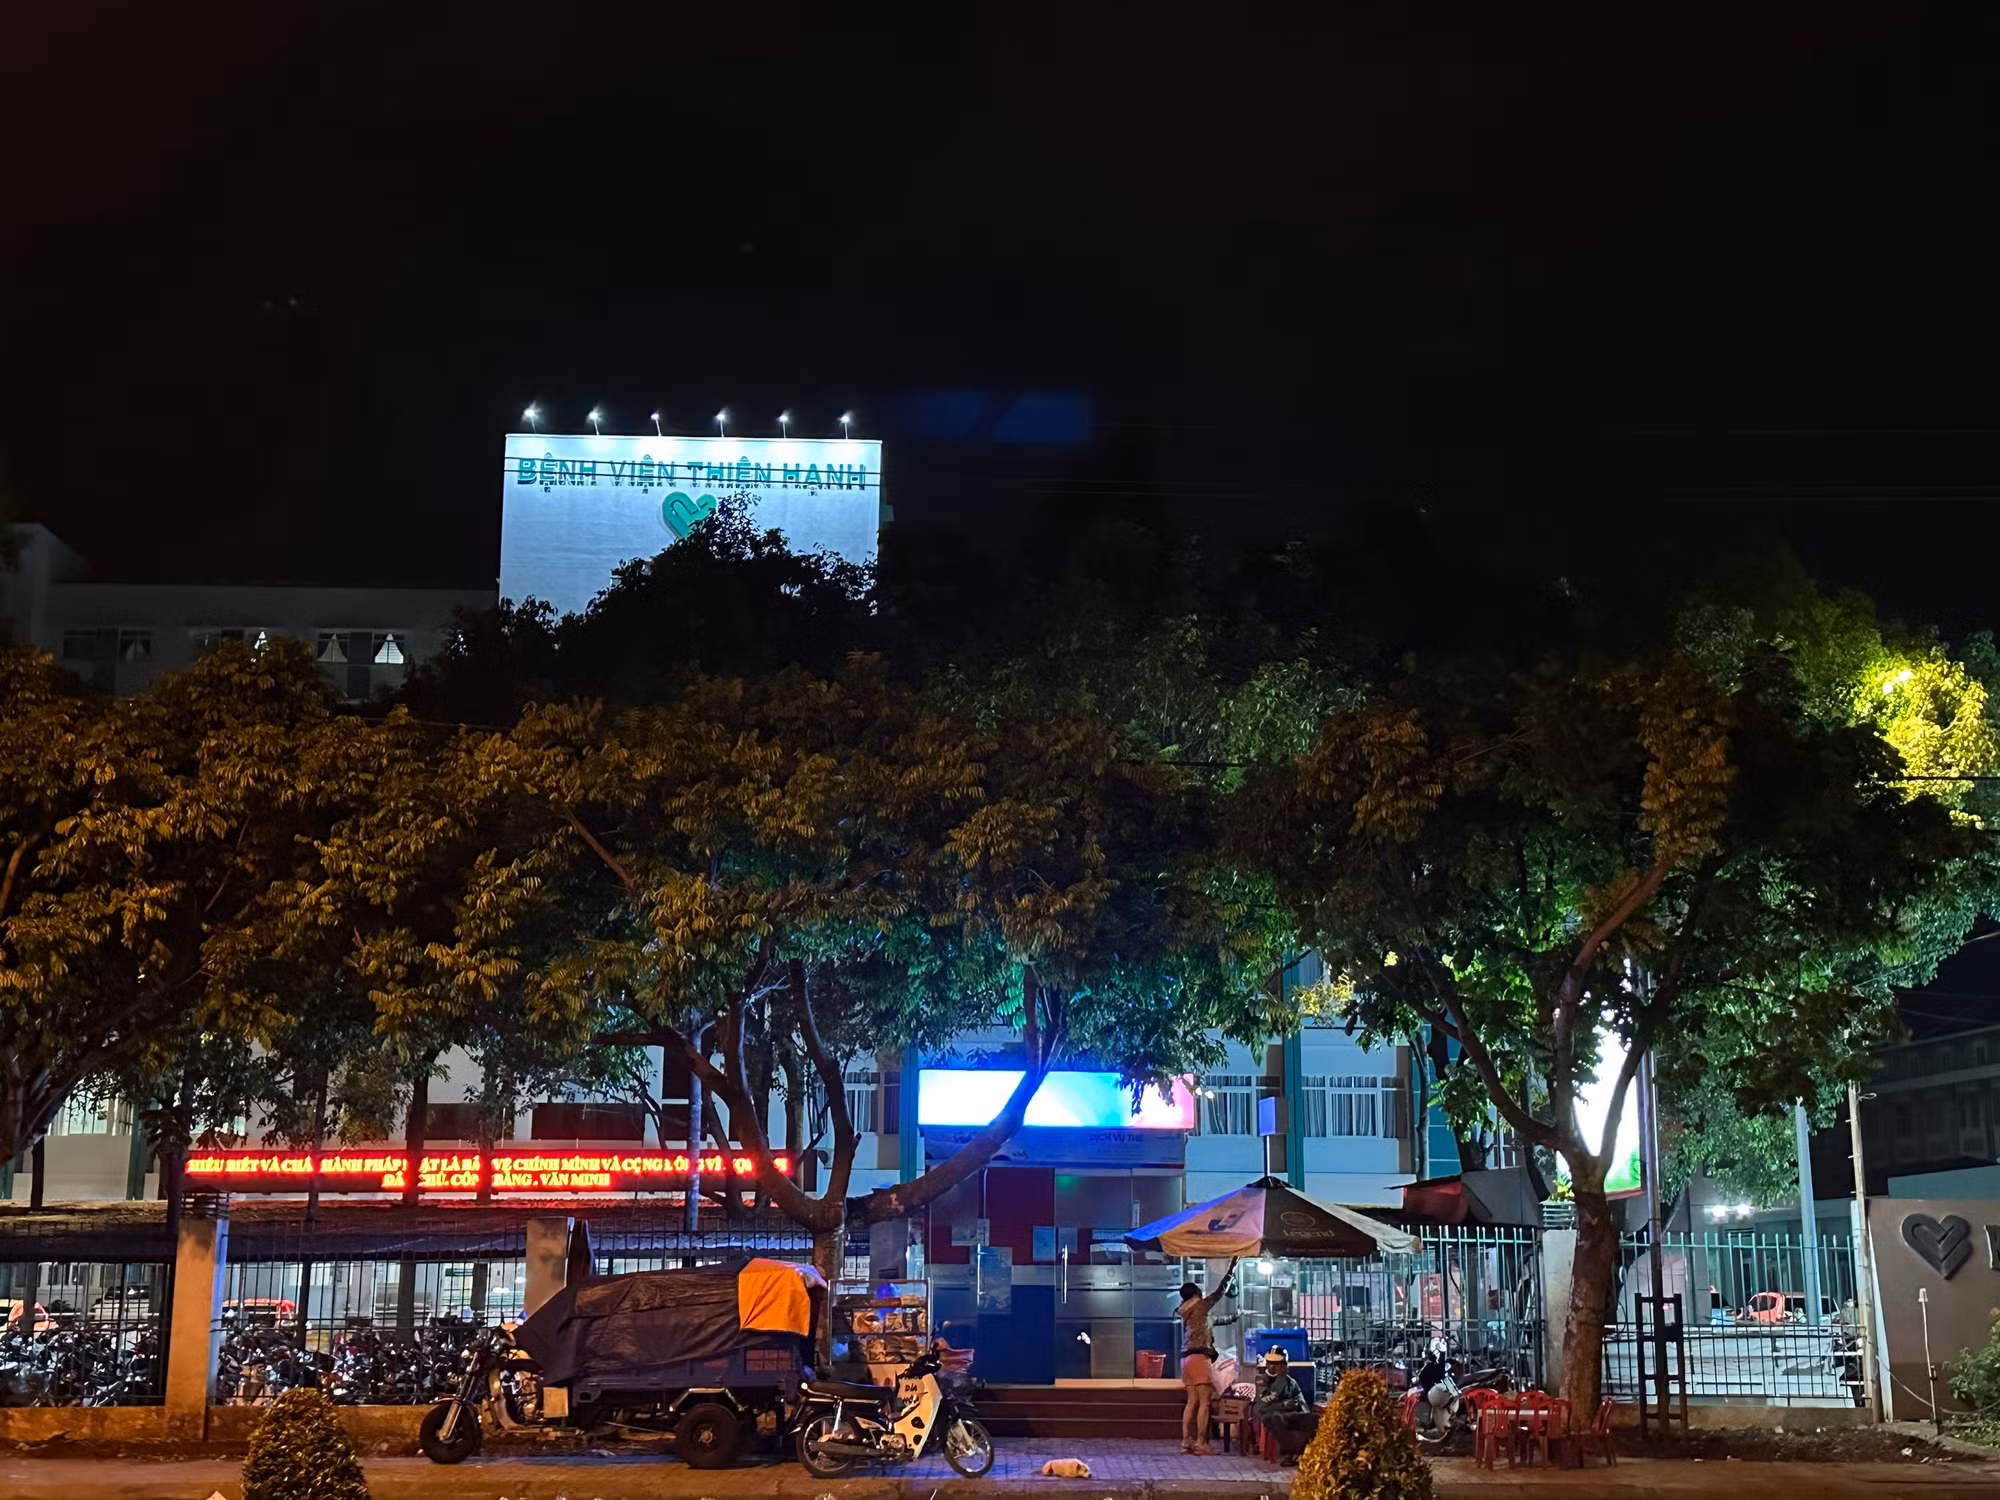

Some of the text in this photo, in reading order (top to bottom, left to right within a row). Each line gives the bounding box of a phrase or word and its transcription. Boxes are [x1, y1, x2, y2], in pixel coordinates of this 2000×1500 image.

[517, 451, 597, 493] BỆNH
[609, 453, 676, 494] VIỆN
[783, 462, 866, 496] HẠNH
[571, 1172, 610, 1186] MINH
